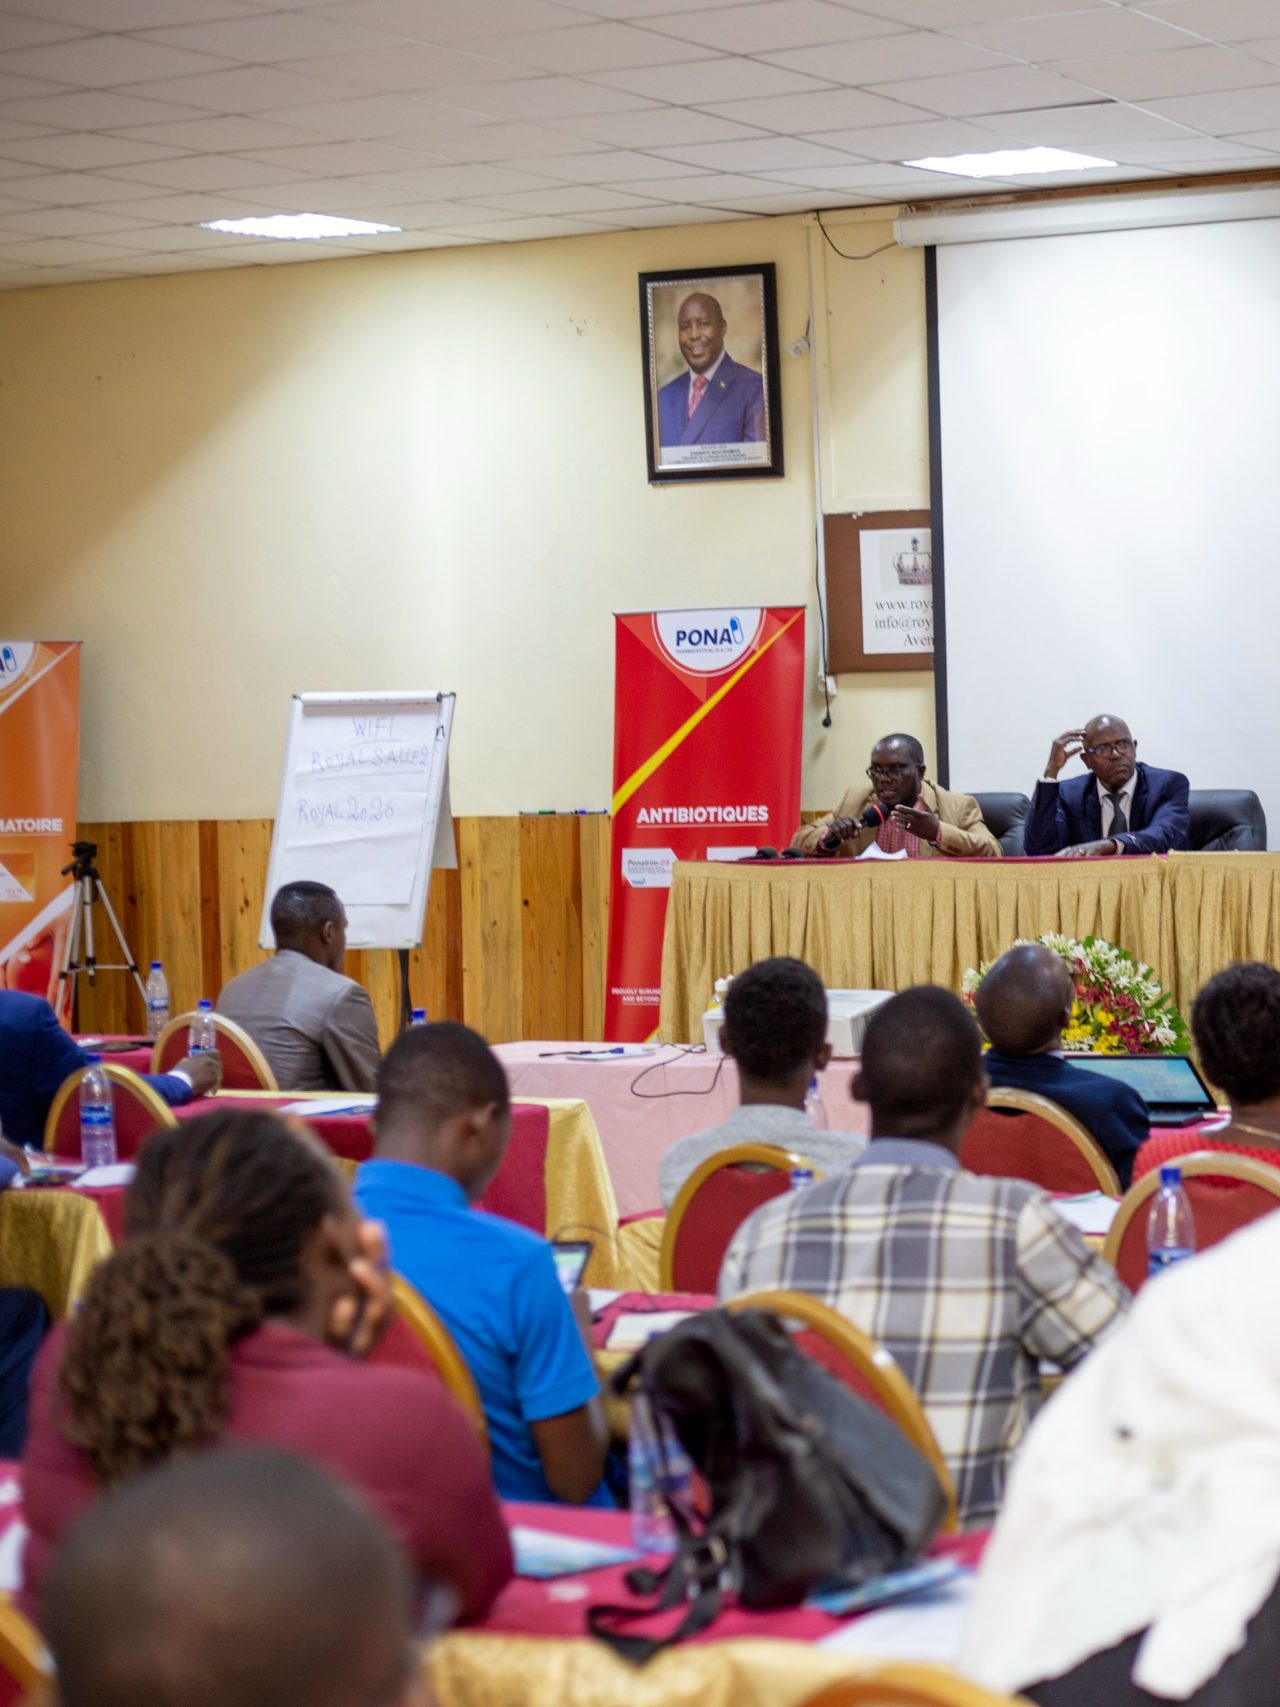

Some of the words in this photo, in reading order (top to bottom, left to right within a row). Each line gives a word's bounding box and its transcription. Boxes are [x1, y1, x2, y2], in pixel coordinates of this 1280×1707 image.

[675, 628, 732, 647] PONA
[352, 715, 396, 738] WIFI
[297, 798, 344, 828] ROYAL
[636, 806, 769, 824] ANTIBIOTIQUES
